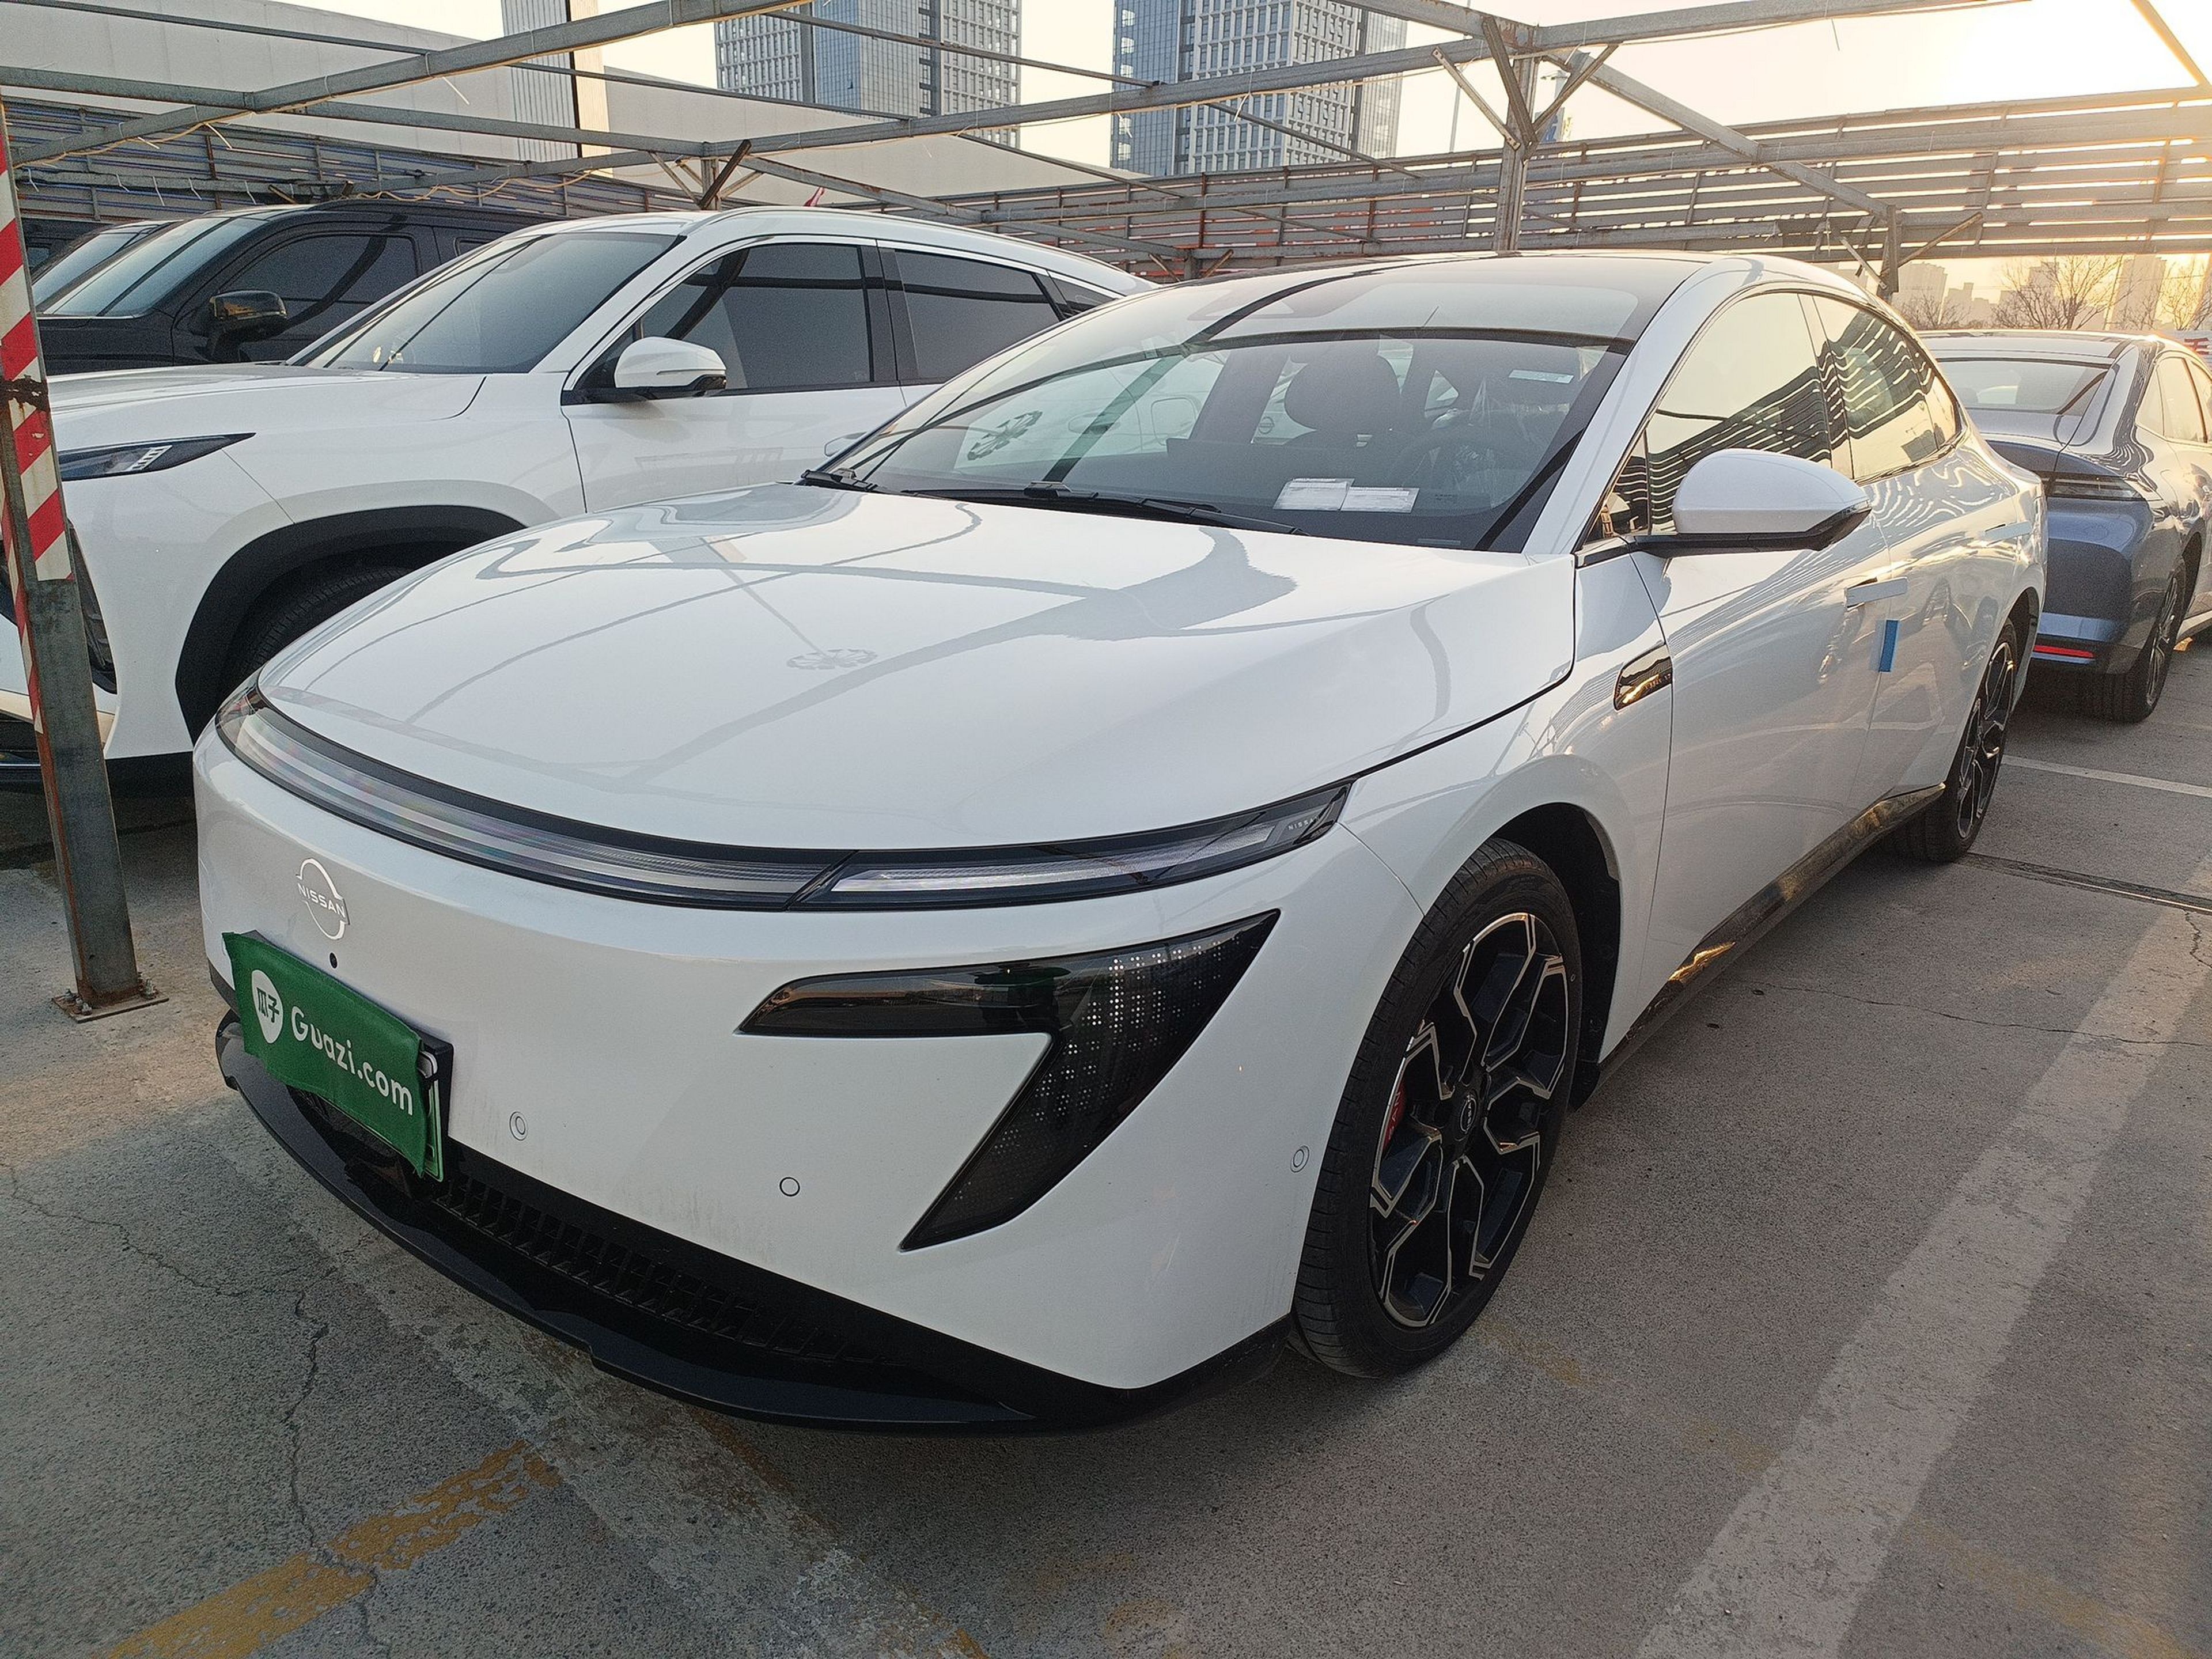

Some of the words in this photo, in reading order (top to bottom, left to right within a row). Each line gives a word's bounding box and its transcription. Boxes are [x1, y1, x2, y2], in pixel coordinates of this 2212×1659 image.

[297, 882, 346, 918] NISSAN
[256, 987, 280, 1024] 瓜子
[291, 1006, 413, 1116] Guazi.com
